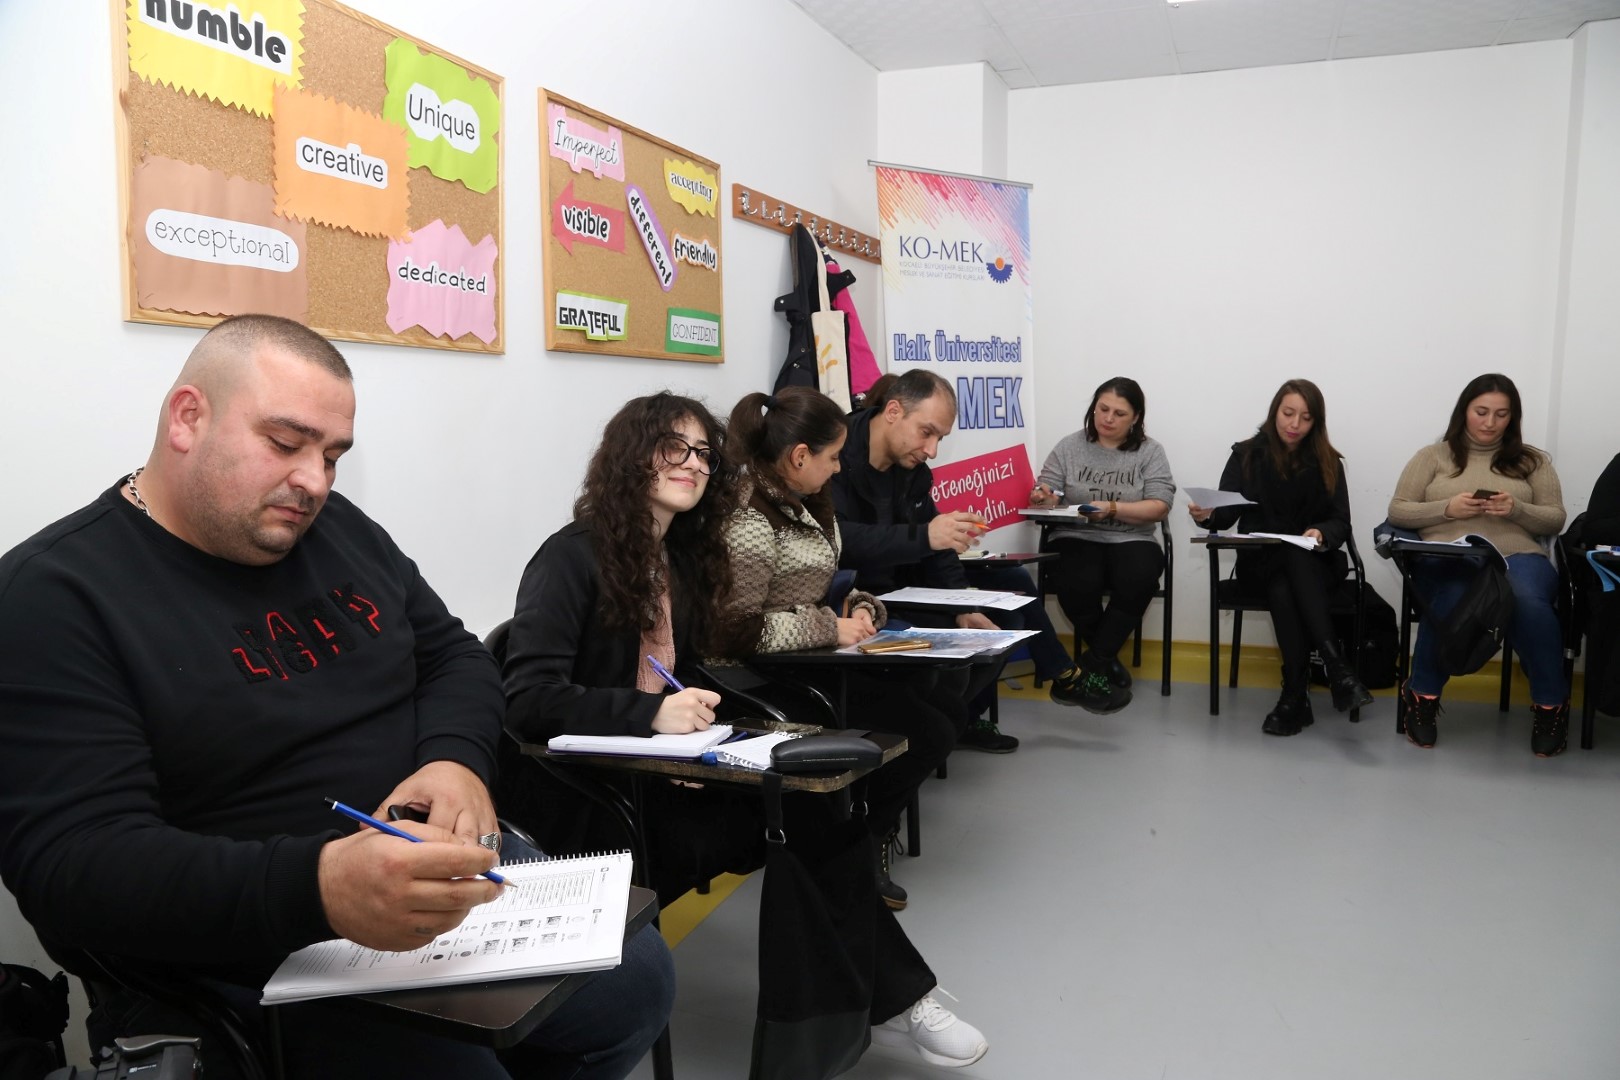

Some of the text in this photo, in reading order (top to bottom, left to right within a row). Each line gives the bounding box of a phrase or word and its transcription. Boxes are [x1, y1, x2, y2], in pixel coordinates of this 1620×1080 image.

[408, 89, 476, 141] Unique
[556, 119, 617, 169] Imperfect
[301, 143, 384, 182] creative
[671, 172, 712, 201] accepting
[564, 208, 608, 239] visible
[154, 220, 290, 264] exceptional
[630, 195, 672, 285] different
[674, 238, 716, 269] friendly
[899, 235, 984, 263] KO-MEK
[398, 262, 486, 293] dedicated
[559, 307, 621, 334] GRATEFUL
[672, 323, 717, 343] CONFIDENT
[893, 330, 1022, 362] Halk Üniversitesi
[929, 457, 1015, 503] eteneğinizi
